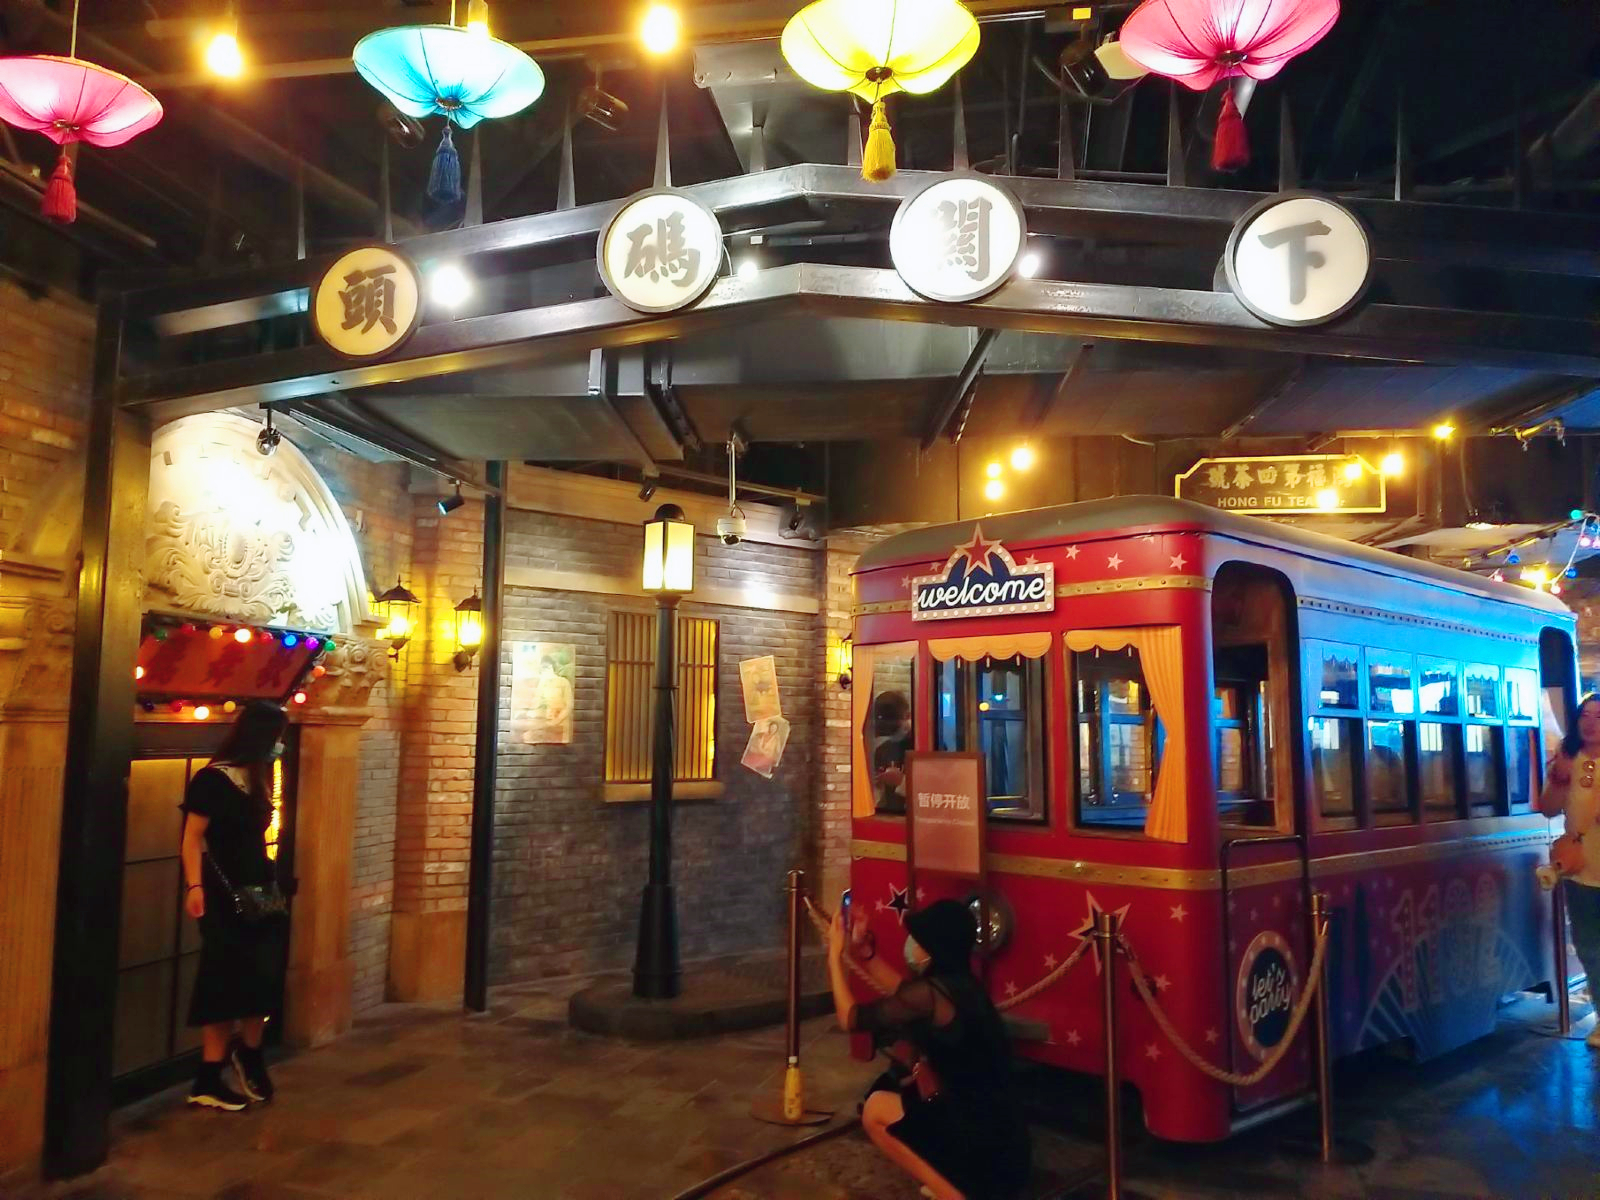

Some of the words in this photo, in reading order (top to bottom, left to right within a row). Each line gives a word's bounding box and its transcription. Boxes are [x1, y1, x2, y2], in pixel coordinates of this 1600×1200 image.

[623, 210, 701, 288] 碼
[1257, 219, 1332, 305] 下
[338, 264, 398, 335] 頭
[1217, 496, 1258, 508] HONG
[1264, 496, 1282, 507] FU
[1288, 496, 1313, 507] TEA
[917, 576, 1047, 609] welcome
[917, 792, 971, 811] 暂停开放
[1252, 961, 1287, 1001] let's
[1249, 981, 1292, 1033] party
